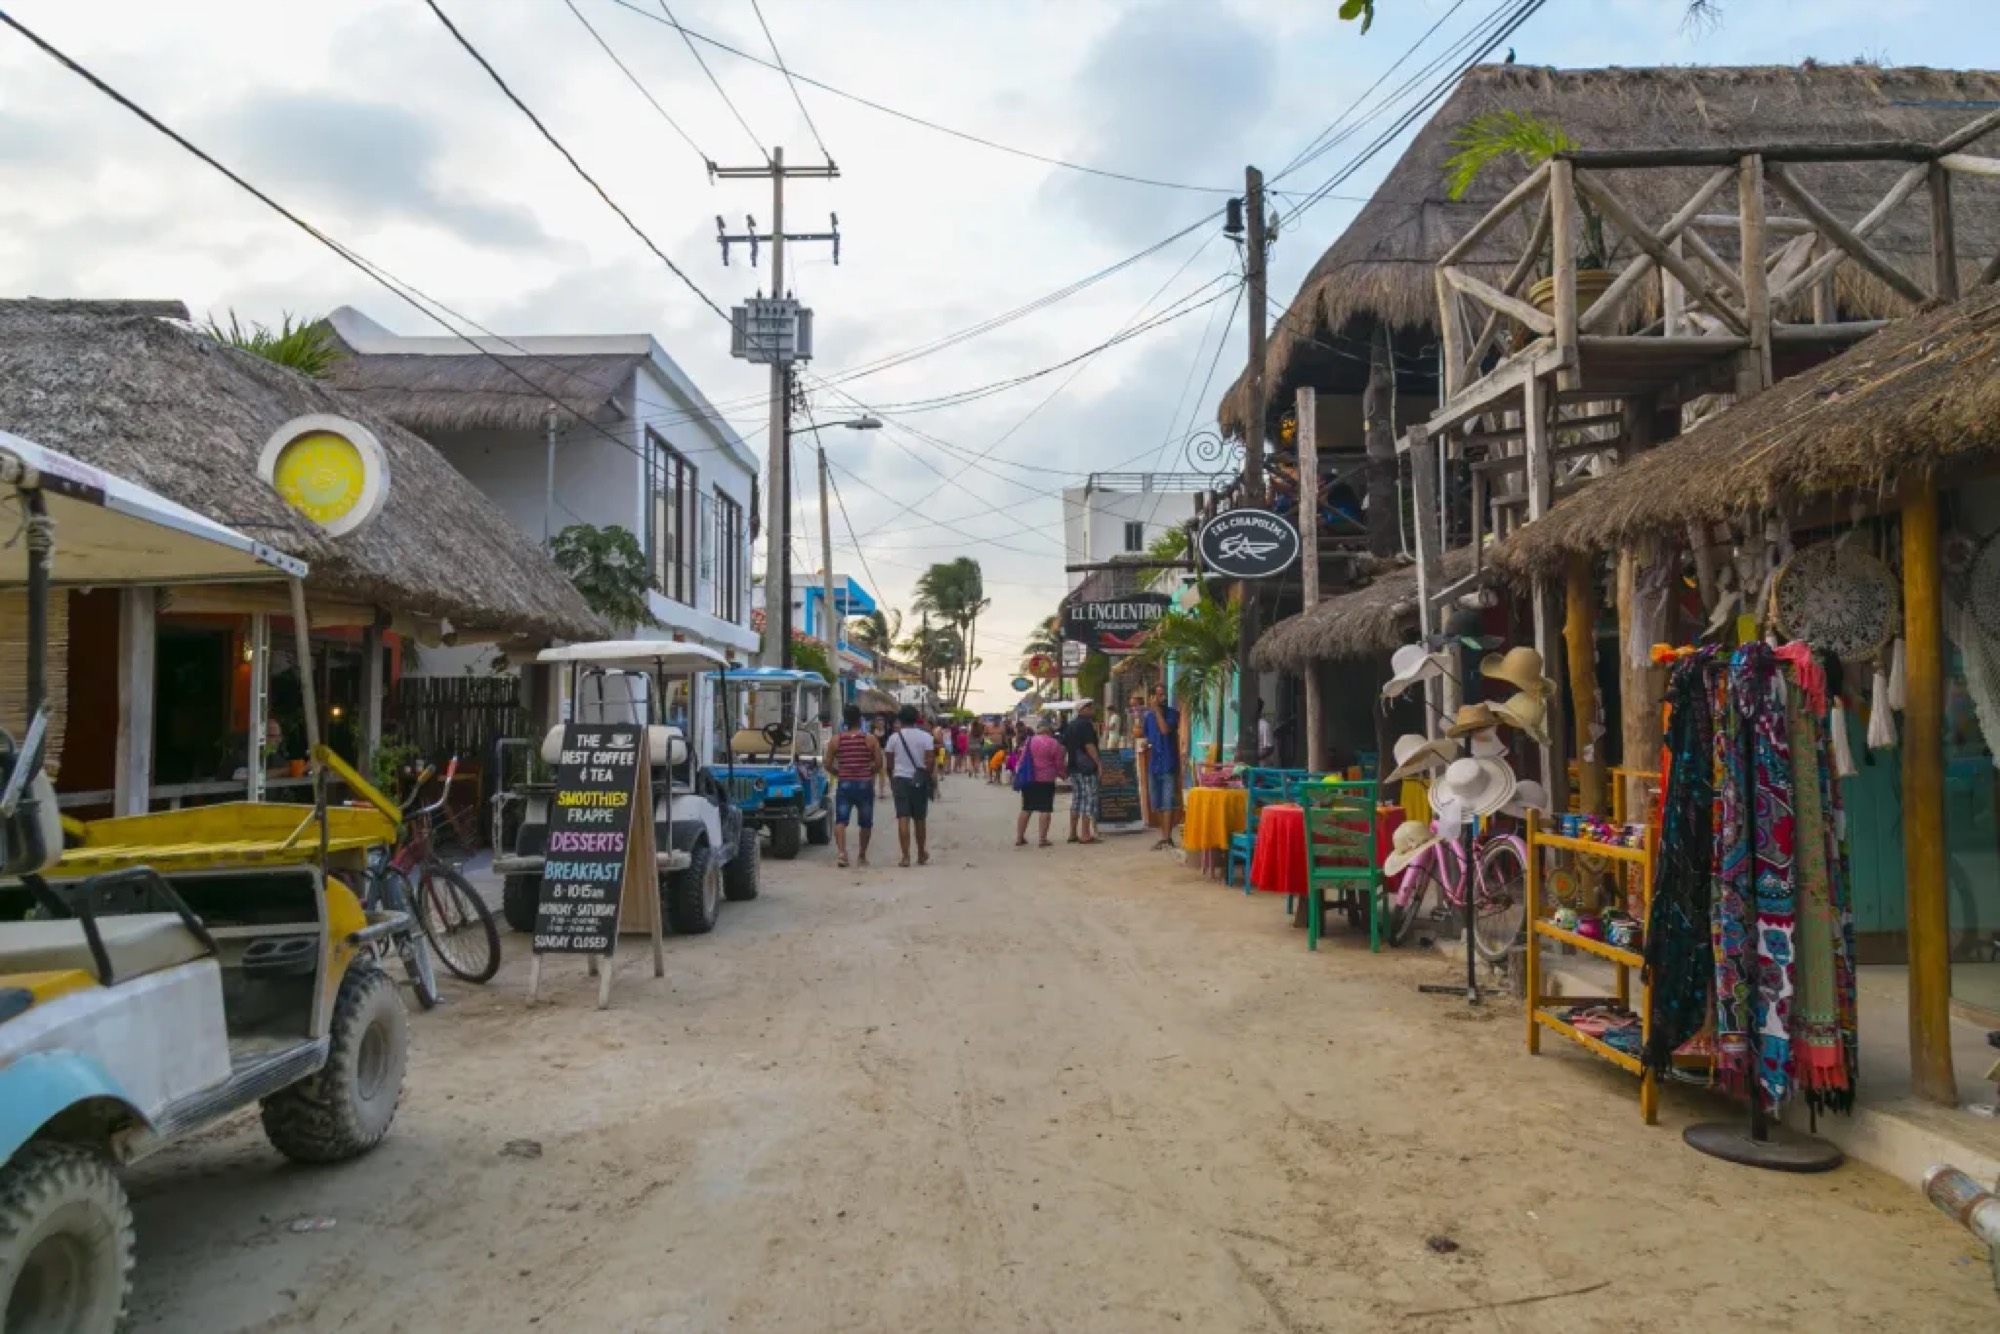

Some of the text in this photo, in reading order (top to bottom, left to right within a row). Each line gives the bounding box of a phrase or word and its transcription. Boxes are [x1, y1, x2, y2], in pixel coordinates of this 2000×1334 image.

[1071, 602, 1161, 620] EL ENCUENTRO
[577, 733, 601, 748] THE
[561, 751, 635, 766] BEST COFFEE
[590, 768, 614, 782] TEA
[557, 790, 628, 807] SMOOTHIES
[567, 808, 614, 823] FRAPPE
[550, 832, 624, 852] DESSERTS
[545, 861, 621, 881] BREAKFAST
[534, 935, 608, 949] SUNDAY CLOSED
